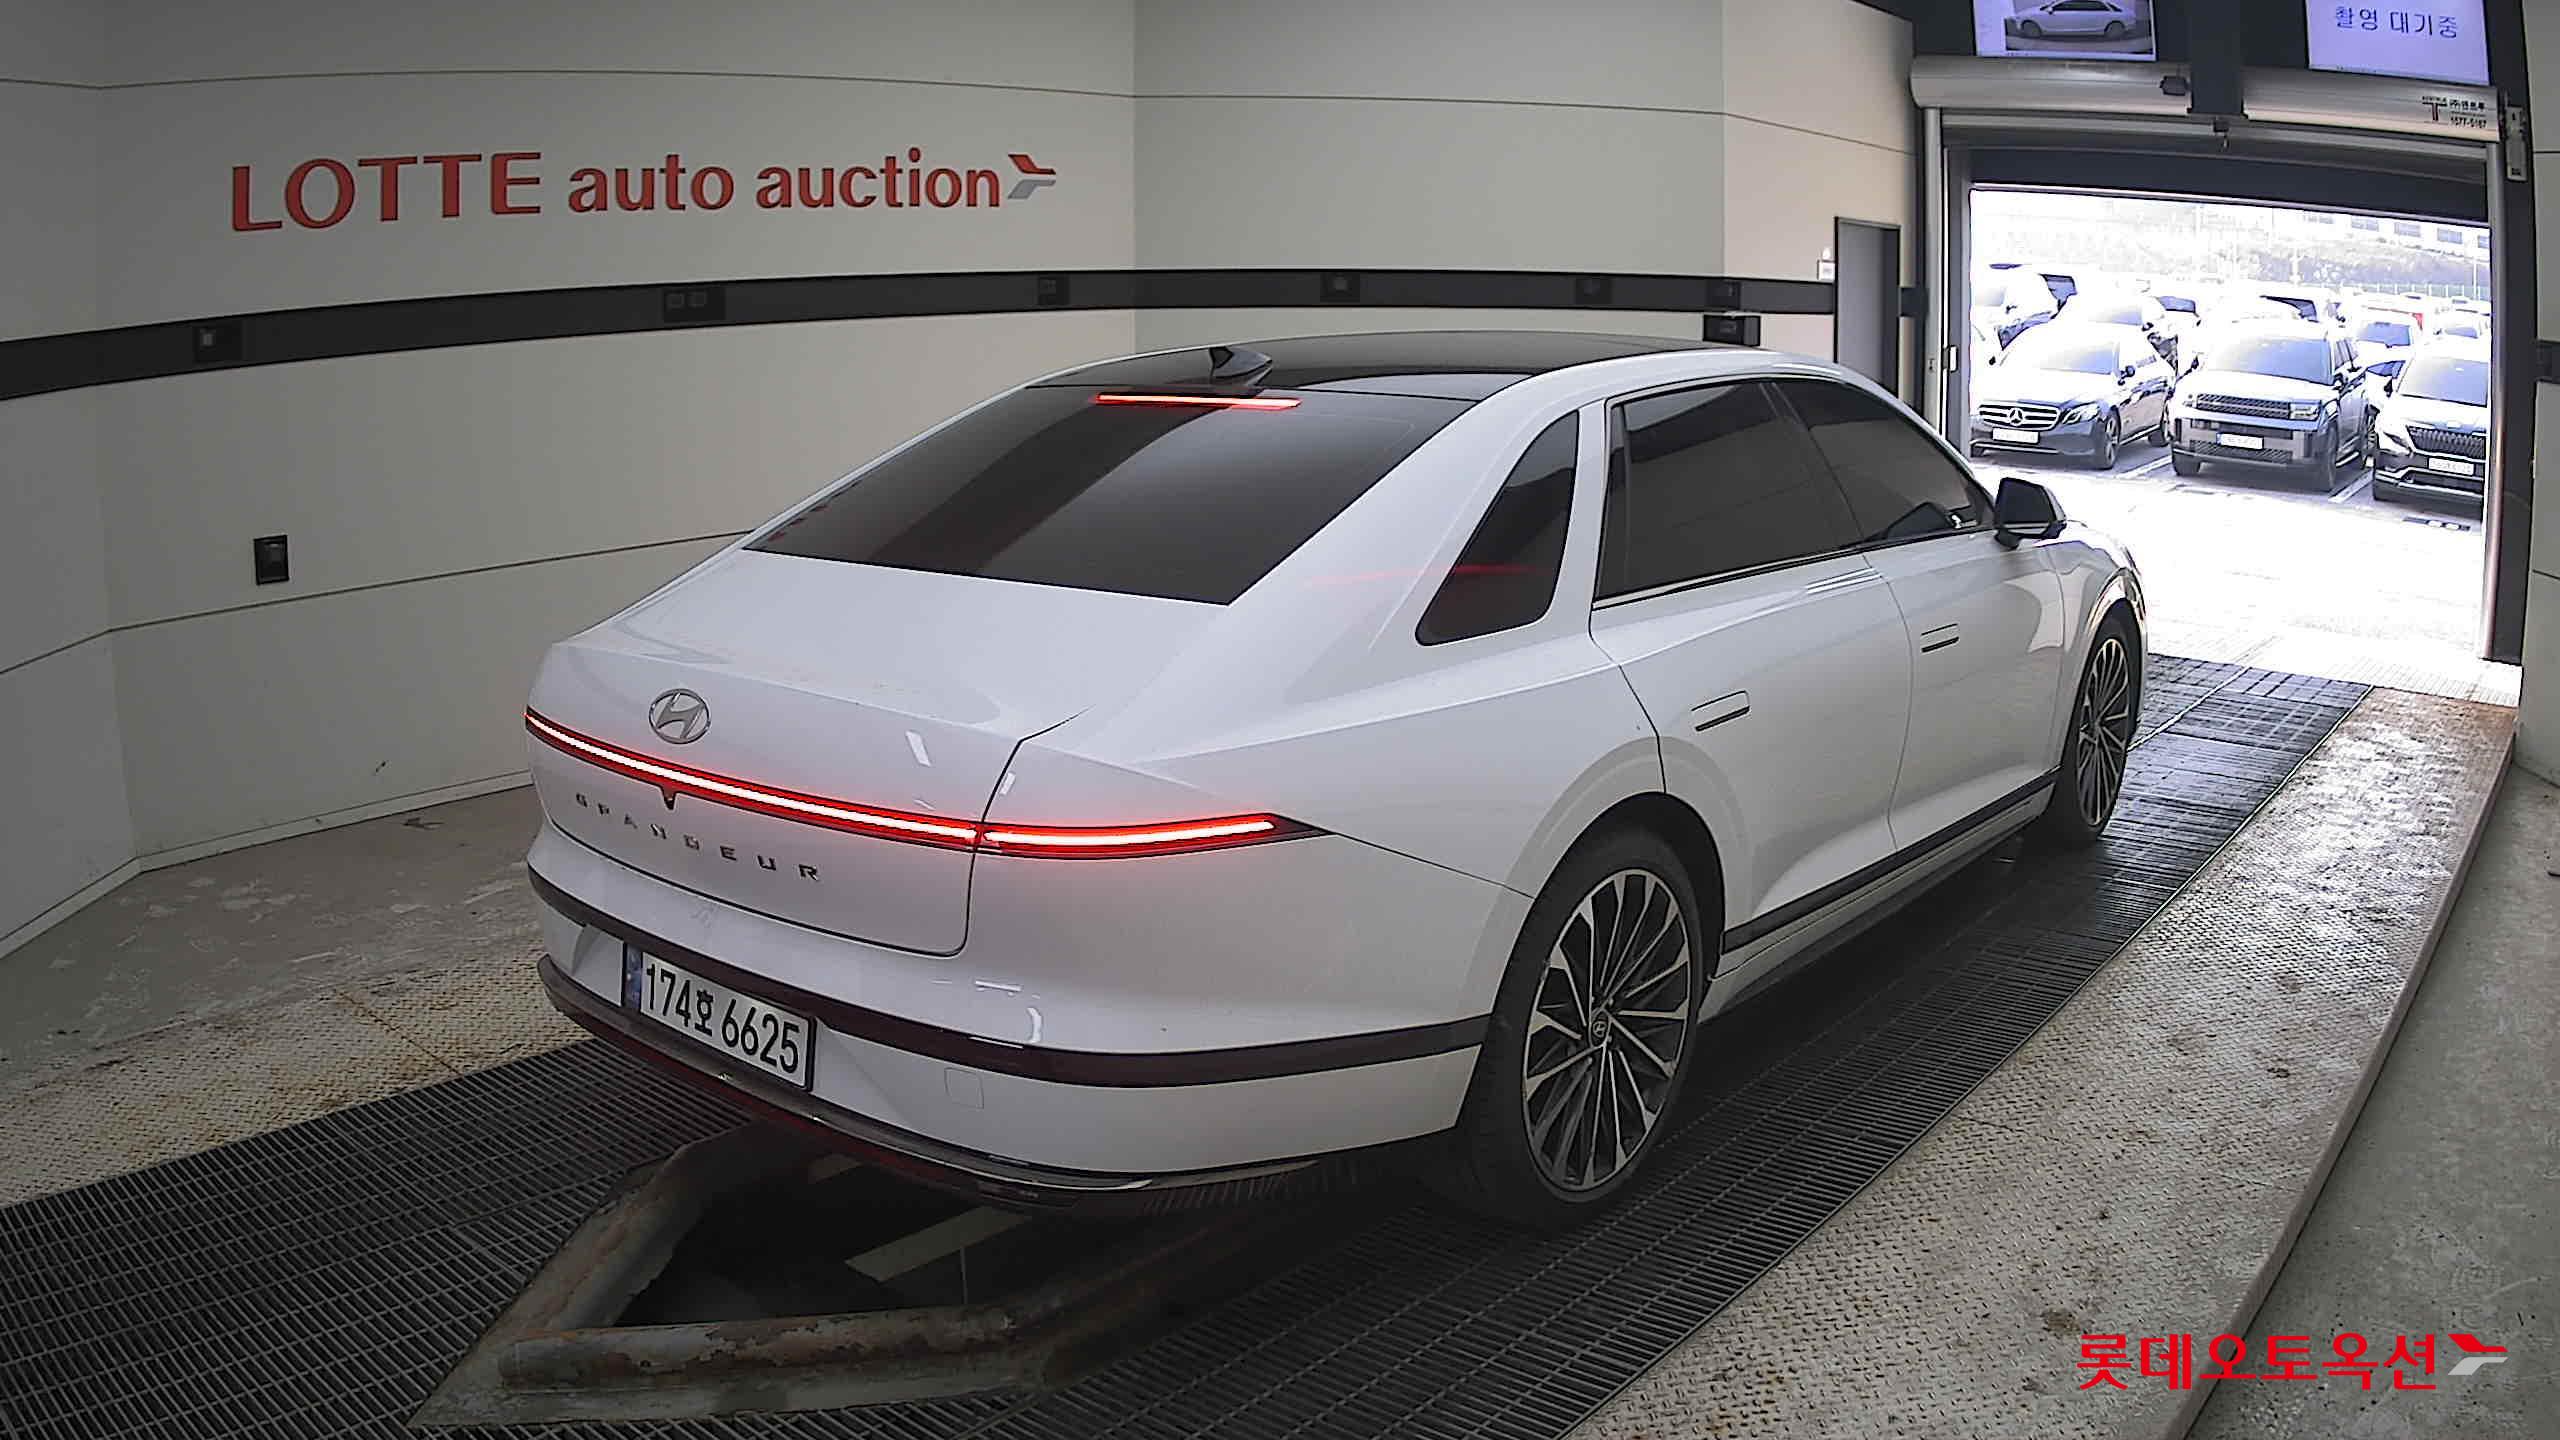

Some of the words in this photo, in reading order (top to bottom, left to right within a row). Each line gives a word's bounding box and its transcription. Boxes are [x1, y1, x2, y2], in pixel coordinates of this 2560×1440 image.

[2335, 6, 2378, 31] 촬영
[2388, 11, 2457, 38] 대기중
[232, 152, 541, 231] LOTTE
[568, 154, 734, 213] auto
[755, 147, 1000, 208] auction
[576, 793, 818, 880] GRANDEUR
[646, 963, 714, 1037] 174호
[721, 998, 799, 1074] 6625
